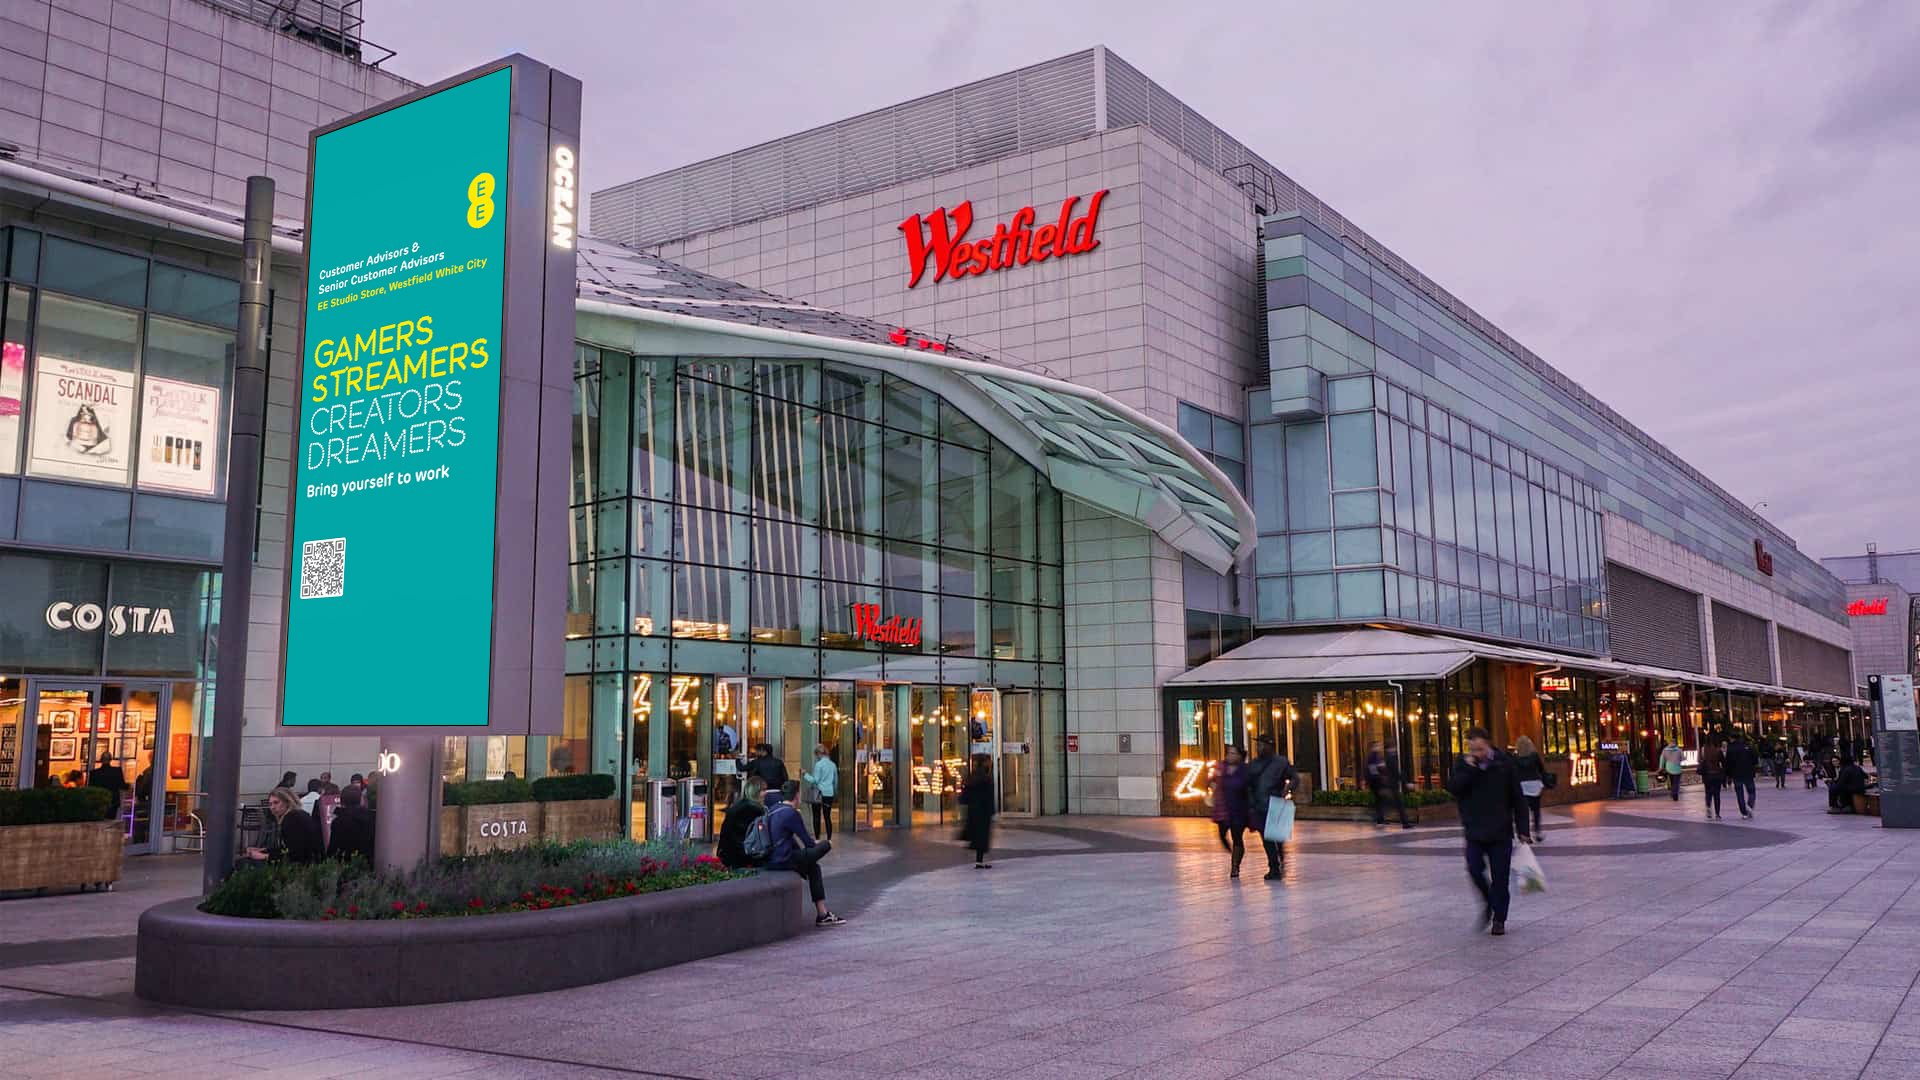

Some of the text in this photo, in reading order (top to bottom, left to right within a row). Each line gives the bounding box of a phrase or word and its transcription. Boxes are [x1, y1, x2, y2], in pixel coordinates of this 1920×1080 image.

[552, 146, 574, 249] OCEAN
[319, 242, 420, 280] Customer Advisors &
[897, 189, 1110, 289] Westfield
[317, 258, 487, 311] EE Studio Store, Westfield White City
[318, 252, 445, 295] Senior Customer Advisors
[314, 315, 433, 368] GAMERS
[57, 378, 118, 406] SCANDAL
[312, 338, 489, 402] STREAMERS
[310, 380, 463, 436] CREATORS
[308, 416, 466, 470] DREAMERS
[307, 464, 450, 498] Bring yourself to work
[46, 601, 175, 637] COSTA
[852, 603, 923, 645] Westfield
[480, 820, 527, 837] COSTA
